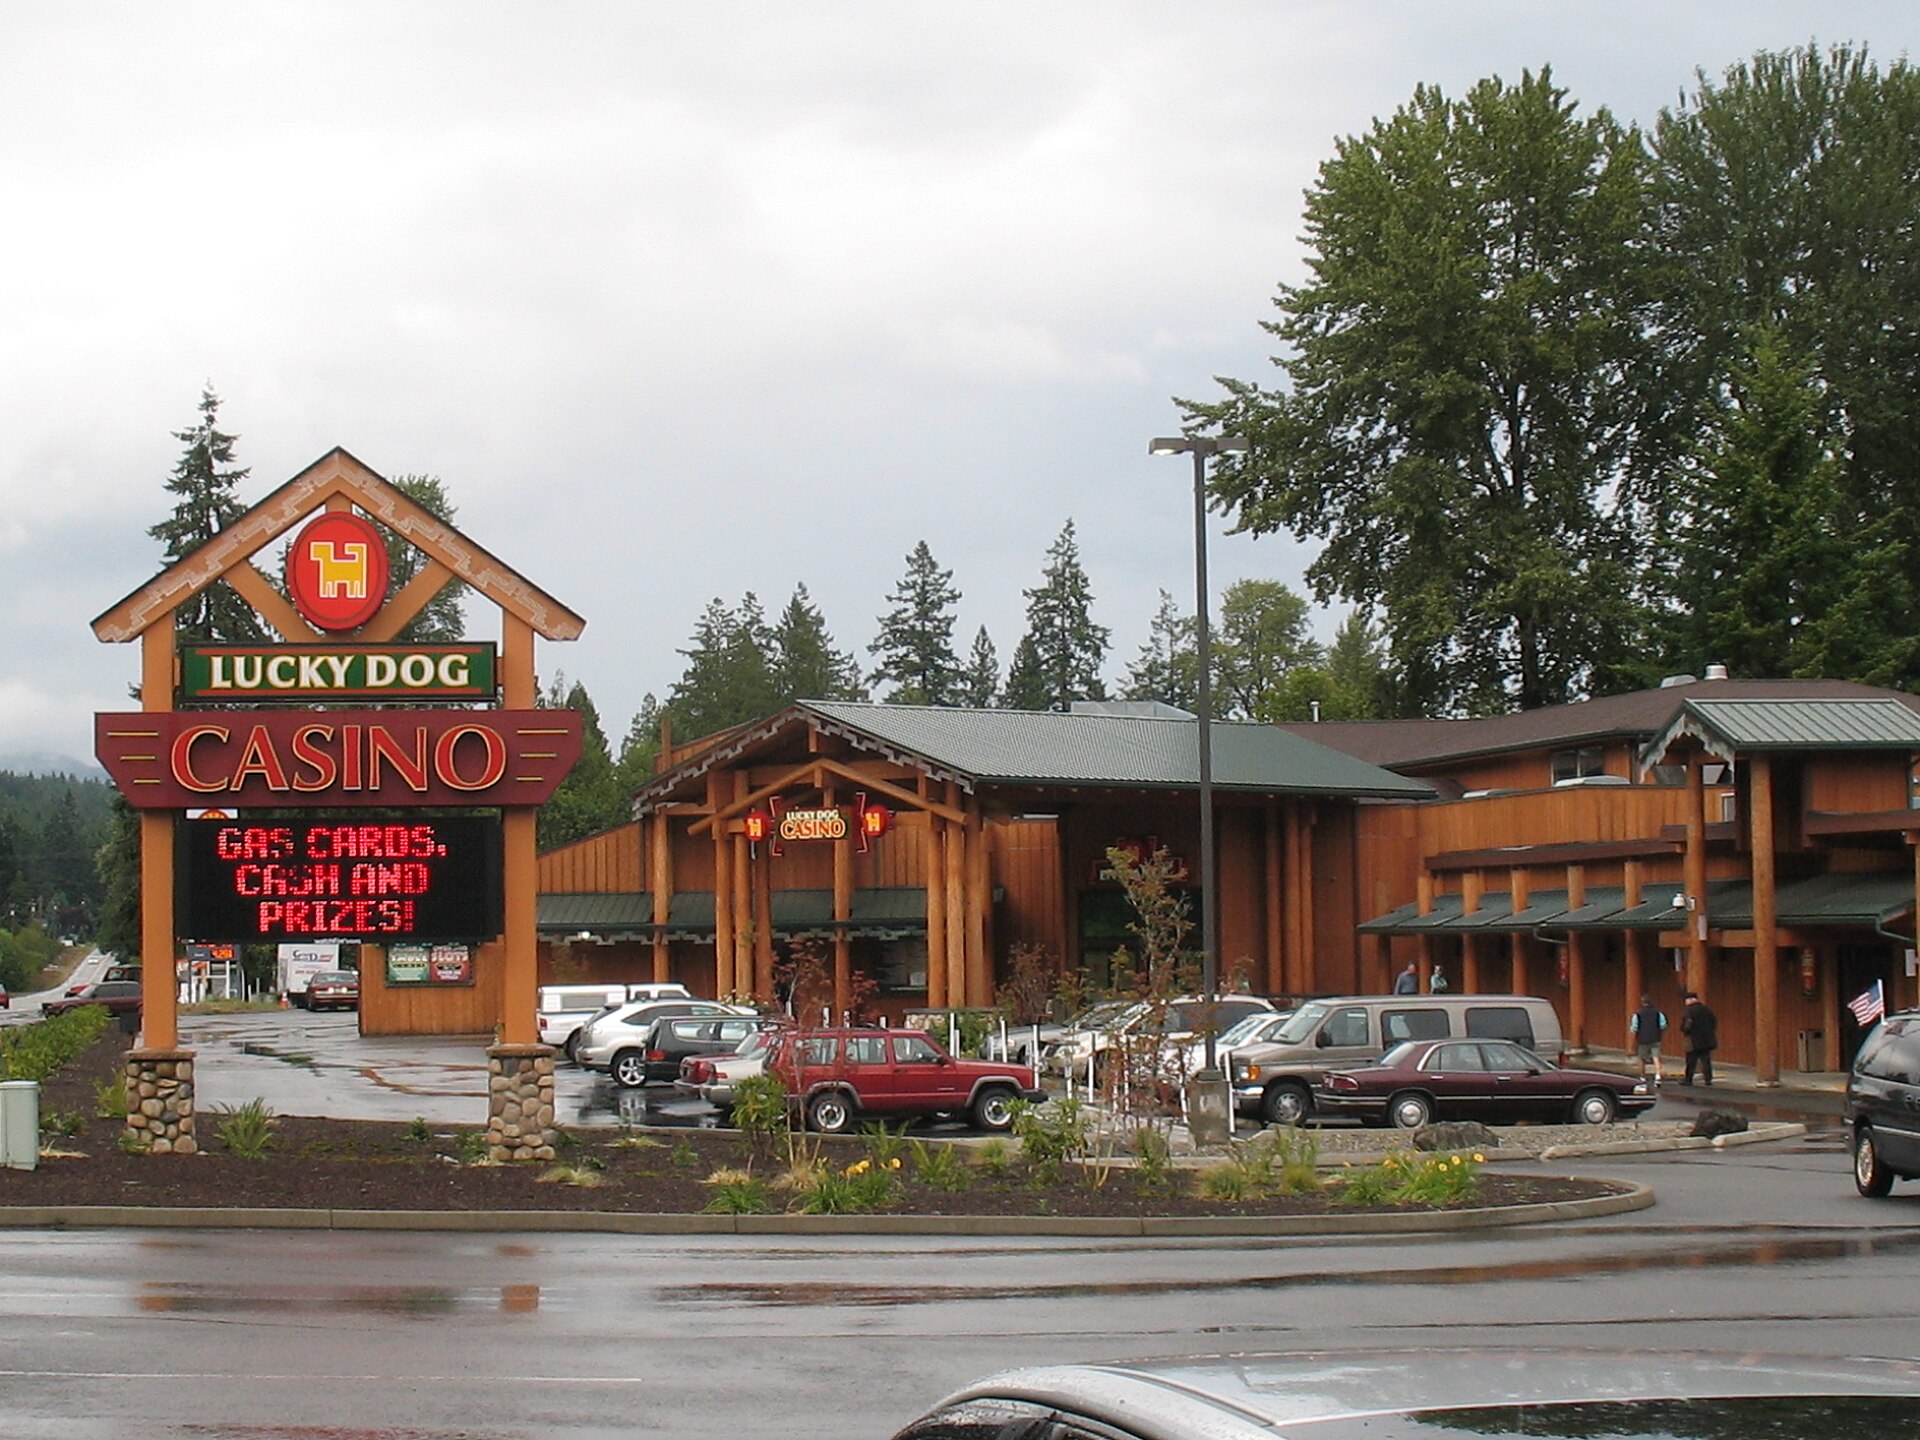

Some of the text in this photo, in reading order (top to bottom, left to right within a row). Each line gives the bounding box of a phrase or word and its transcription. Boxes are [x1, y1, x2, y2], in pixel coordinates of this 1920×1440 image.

[210, 653, 470, 690] LUCKY DOG
[171, 723, 507, 792] CASINO
[780, 818, 846, 839] CASINO
[786, 809, 839, 820] LUCKY DOG
[216, 826, 295, 860] GAS
[351, 862, 430, 895] AND
[258, 899, 415, 933] PRIZES!
[431, 951, 469, 962] SLOTS
